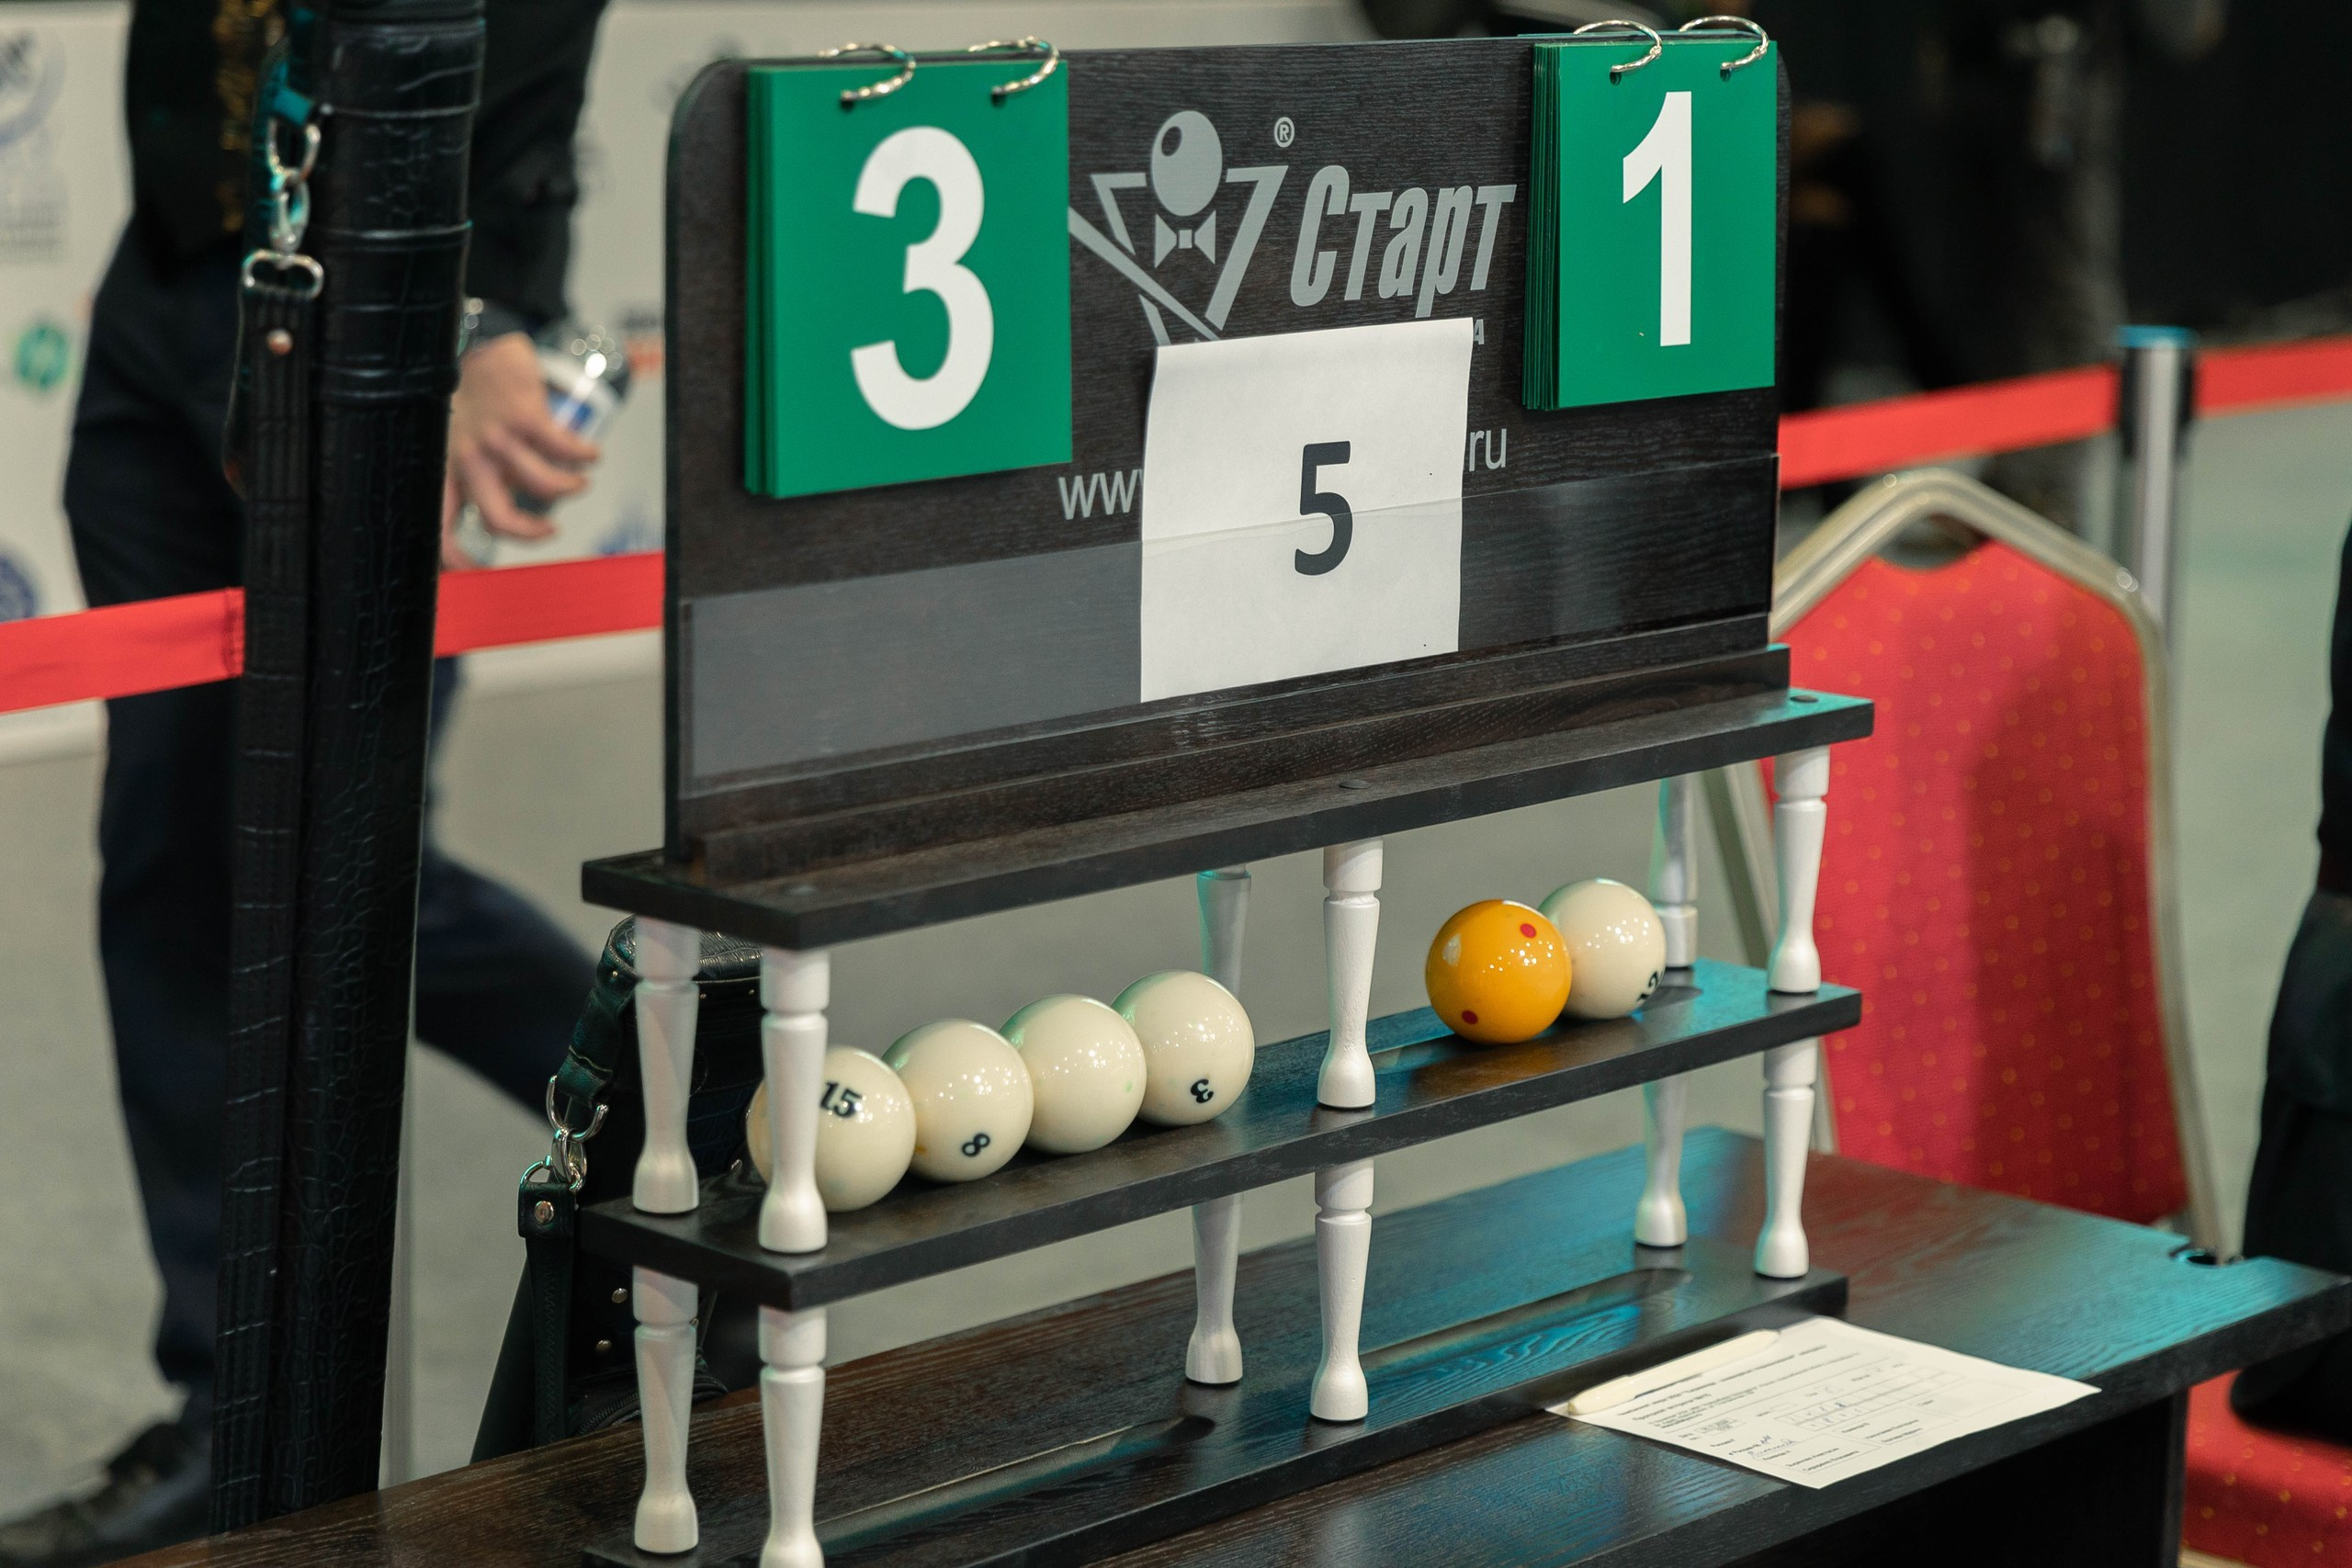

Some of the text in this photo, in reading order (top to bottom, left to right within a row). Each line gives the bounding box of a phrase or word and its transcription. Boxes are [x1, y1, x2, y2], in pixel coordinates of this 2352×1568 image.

[1290, 164, 1518, 319] Старт
[1623, 91, 1693, 347] 1
[851, 125, 995, 431] 3
[1057, 469, 1144, 521] ww
[1294, 440, 1354, 576] 5
[820, 1078, 862, 1118] 15
[1190, 1078, 1215, 1104] 3
[961, 1133, 991, 1157] 8
